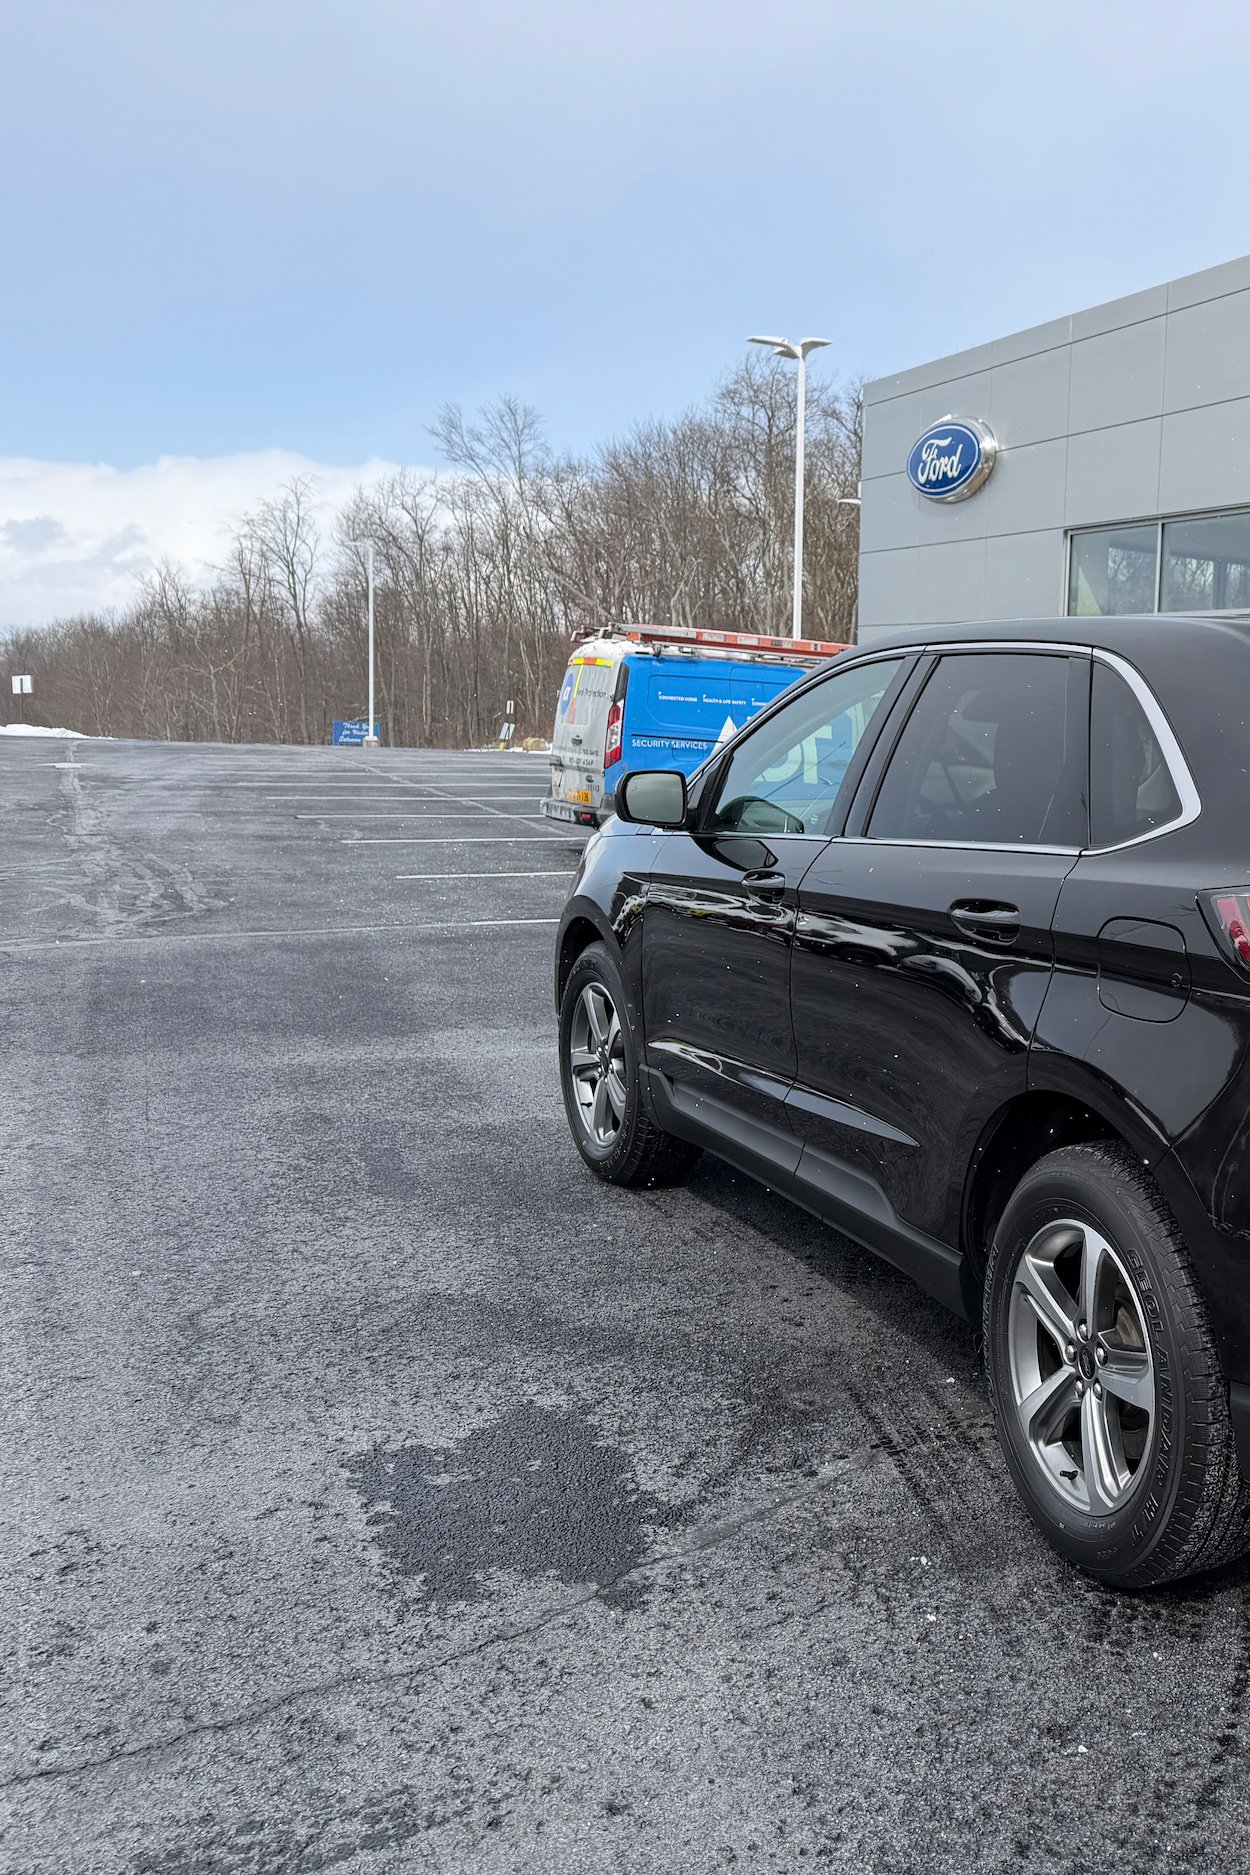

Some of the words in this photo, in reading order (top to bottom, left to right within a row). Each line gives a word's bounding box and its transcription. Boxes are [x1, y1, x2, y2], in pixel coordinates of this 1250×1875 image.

[918, 437, 963, 484] Ford
[631, 739, 670, 748] SECURITY
[671, 740, 708, 750] SERVICES
